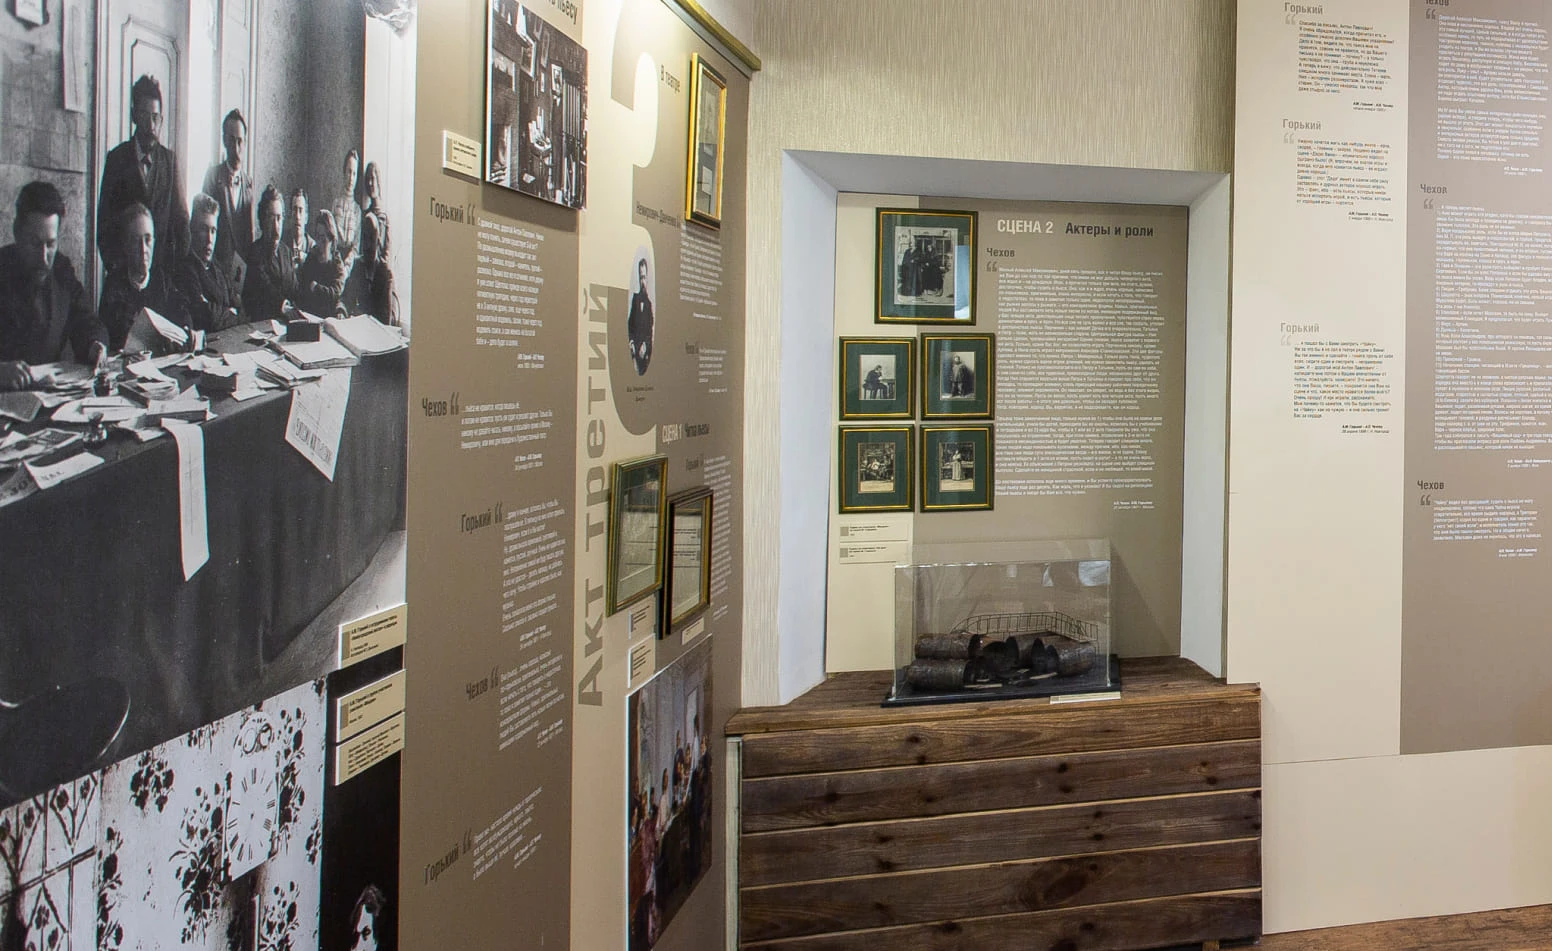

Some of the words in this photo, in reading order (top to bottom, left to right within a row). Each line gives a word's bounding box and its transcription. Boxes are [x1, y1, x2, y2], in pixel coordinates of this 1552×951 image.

[1284, 2, 1324, 15] Горький
[1282, 118, 1322, 131] Горький
[1420, 184, 1448, 194] Чехов
[430, 197, 464, 224] Горький
[997, 219, 1042, 234] СЦЕНА
[1045, 221, 1054, 234] 2
[1065, 223, 1111, 237] Актеры
[1114, 226, 1121, 235] и
[1125, 226, 1154, 238] роли
[986, 248, 1015, 258] Чехов
[1280, 322, 1320, 335] Горький
[422, 398, 448, 417] Чехов
[583, 283, 609, 552] третий
[1417, 480, 1445, 490] Чехов
[461, 508, 491, 534] Горький
[578, 578, 603, 707] Акт
[465, 675, 489, 701] Чехов
[424, 842, 460, 885] Горький
